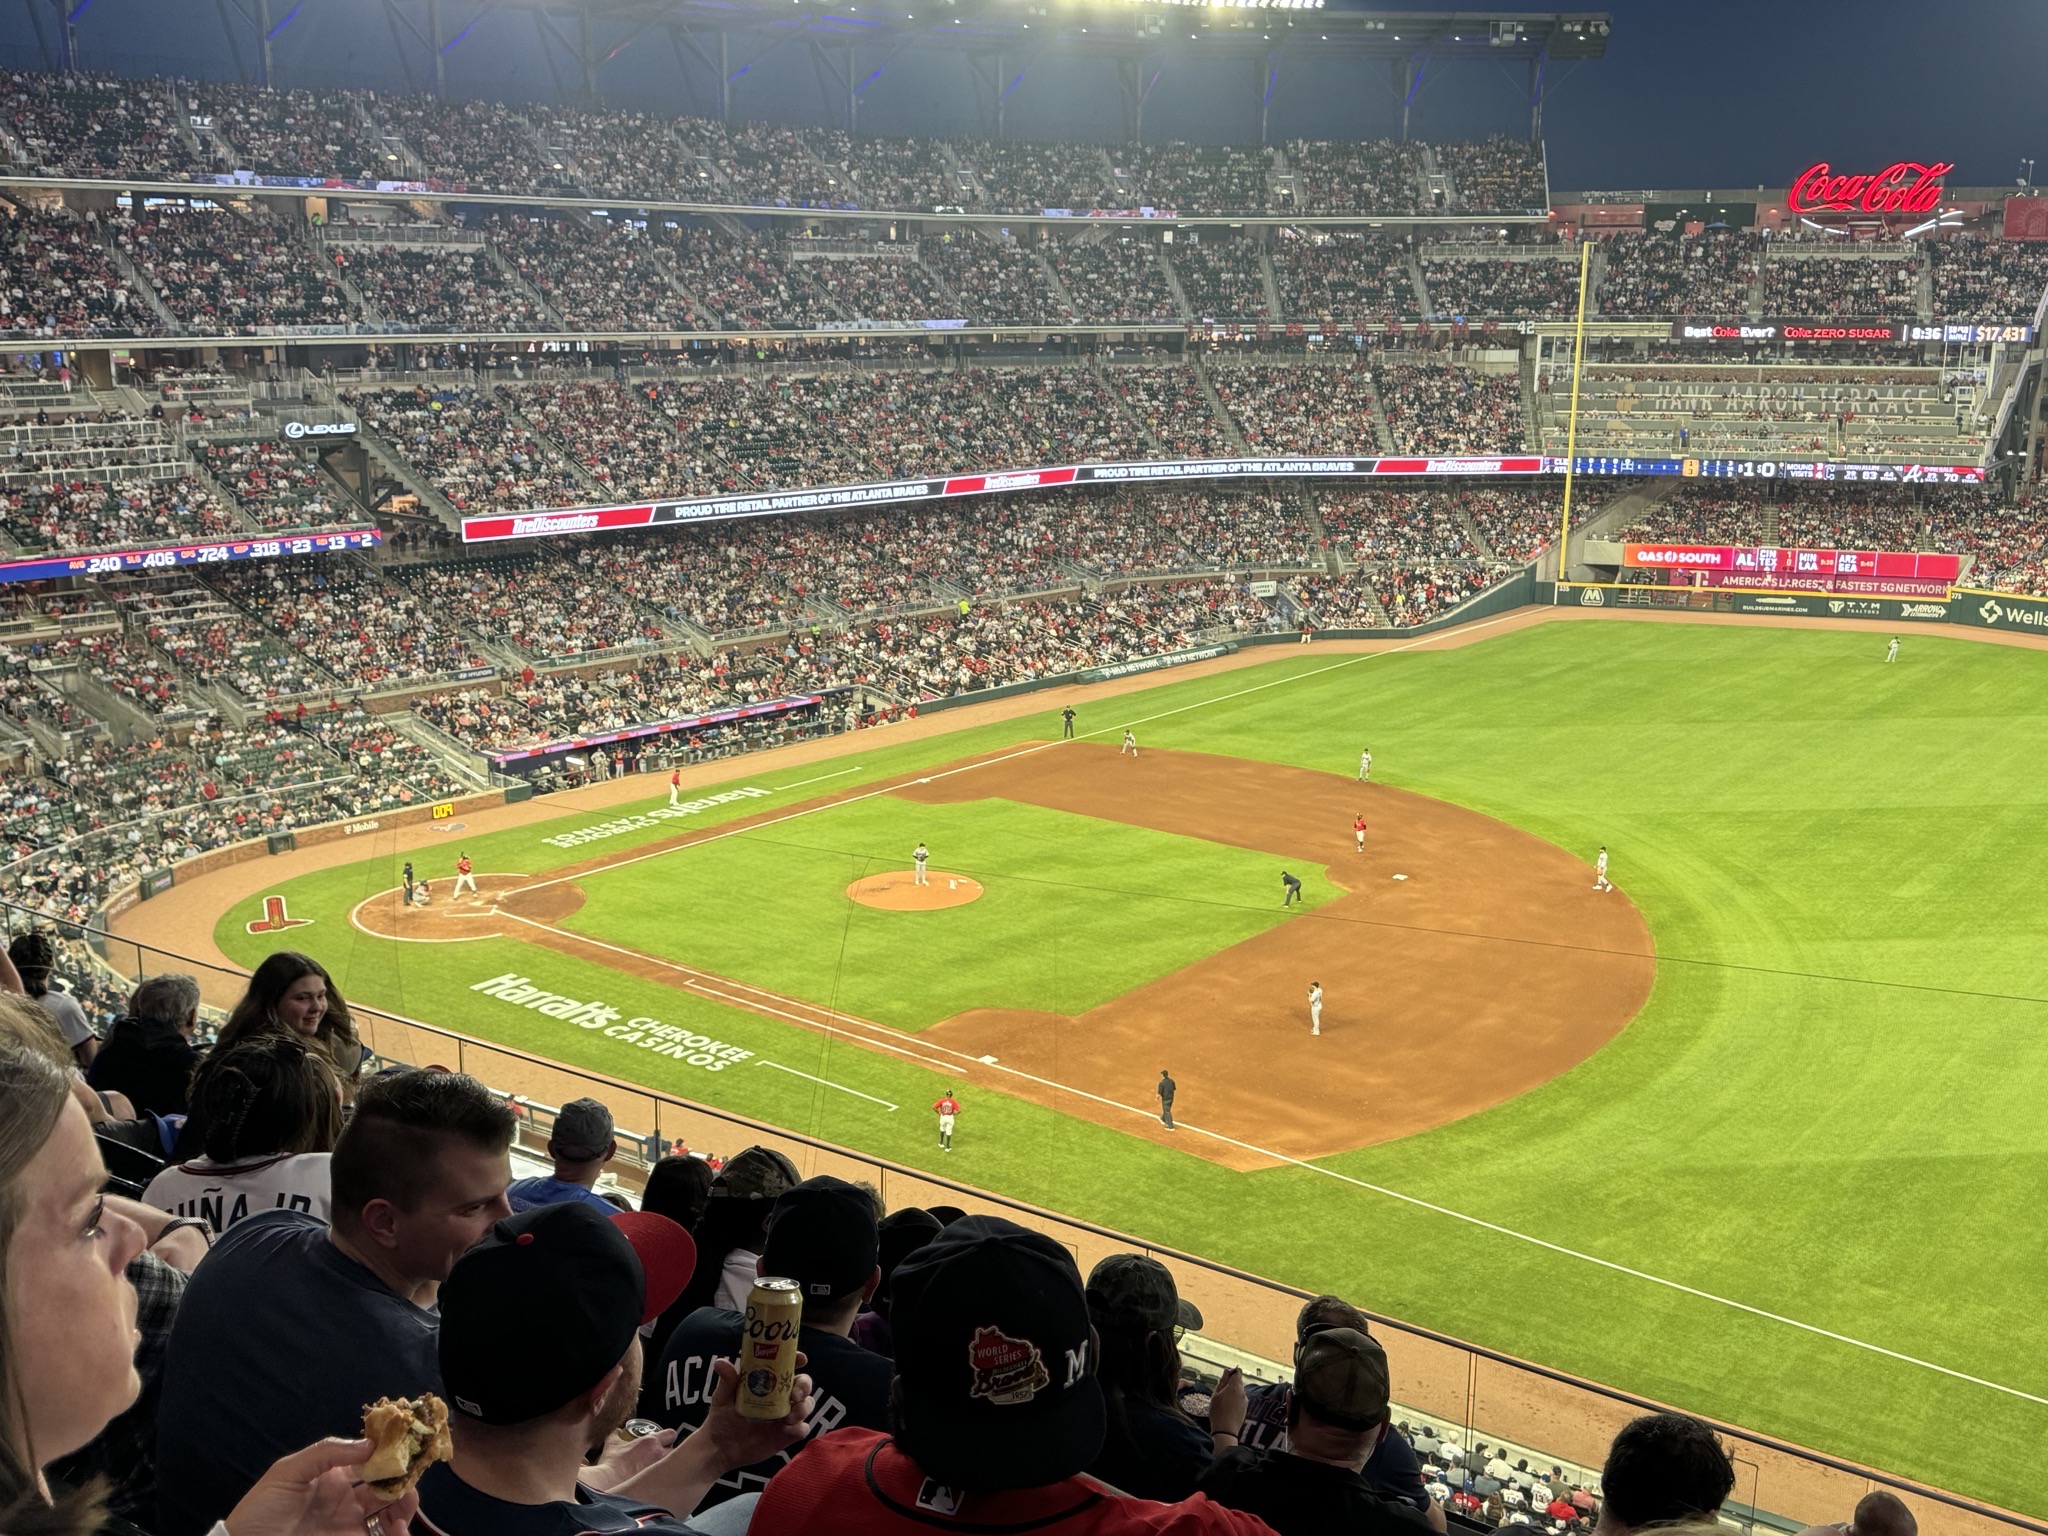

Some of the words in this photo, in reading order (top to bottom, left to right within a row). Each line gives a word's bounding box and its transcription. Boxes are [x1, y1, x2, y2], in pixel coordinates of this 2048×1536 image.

[1787, 161, 1955, 213] Coca-Cola
[1285, 322, 1303, 337] 25
[1450, 321, 1469, 336] 44
[1482, 321, 1499, 336] 47
[1516, 320, 1535, 336] 42
[1684, 326, 1712, 338] Best
[1740, 326, 1776, 338] Ever?
[1813, 328, 1846, 338] ZERO
[1848, 328, 1890, 338] SUGAR
[1912, 327, 1942, 340] 8:36
[1976, 326, 2027, 342] $17,431
[1655, 385, 1715, 411] HANK
[1725, 386, 1805, 412] AARON
[1818, 387, 1930, 414] TERRACE
[304, 423, 356, 435] LEXUS
[1093, 468, 1128, 478] PROUD
[1129, 467, 1150, 477] TIRE
[1151, 465, 1184, 476] RETAIL
[1184, 464, 1227, 474] PARTNER
[1228, 463, 1242, 473] OF
[1242, 463, 1262, 472] THE
[1263, 462, 1312, 472] ATLANTA
[1312, 462, 1355, 472] BRAVES
[1743, 461, 1754, 477] 1
[1761, 462, 1776, 478] 0
[1790, 470, 1814, 478] VISITS
[1944, 473, 1958, 482] 70
[675, 505, 713, 519] PROUD
[714, 502, 737, 514] TIRE
[736, 499, 772, 513] RETAIL
[772, 495, 817, 509] PARTNER
[818, 493, 832, 505] OF
[832, 491, 850, 503] THE
[852, 487, 892, 502] ATLANTA
[892, 484, 928, 498] BRAVES
[87, 556, 122, 574] .240
[142, 551, 176, 569] .406
[197, 546, 229, 563] .724
[249, 541, 281, 558] .318
[292, 539, 312, 554] 23
[328, 536, 346, 551] 13
[361, 533, 373, 548] 2
[1637, 551, 1664, 562] GAS
[1678, 552, 1721, 565] SOUTH
[1735, 553, 1756, 567] AL
[1759, 549, 1777, 558] CIN
[1786, 551, 1792, 559] 1
[1799, 553, 1817, 562] MIN
[1839, 554, 1857, 564] ARZ
[1759, 557, 1777, 567] TEX
[1786, 559, 1792, 567] 0
[1798, 561, 1818, 571] LAA
[1838, 563, 1858, 573] SEA
[1722, 575, 1778, 588] AMERICAS
[1825, 580, 1834, 590] &
[1835, 580, 1879, 592] FASTEST
[1880, 582, 1895, 593] 5G
[1895, 583, 1947, 595] NETWORK
[1951, 593, 1962, 601] 375
[1742, 605, 1808, 613] BUILDSUBMARINES.COM
[1913, 603, 1940, 614] ARROW
[467, 668, 493, 679] HYUNDAI
[432, 803, 454, 820] 009
[469, 972, 622, 1029] Harrah's
[627, 1017, 755, 1063] CHEROKEE
[603, 1025, 732, 1072] CASINOS
[164, 1187, 248, 1234] ÑA
[742, 1306, 802, 1341] Coors
[977, 1344, 1009, 1359] WORLD
[993, 1350, 1022, 1366] SERIES
[1063, 1339, 1088, 1390] M
[666, 1354, 740, 1411] ACU
[1012, 1391, 1028, 1401] 1957
[1249, 1395, 1288, 1428] TL
